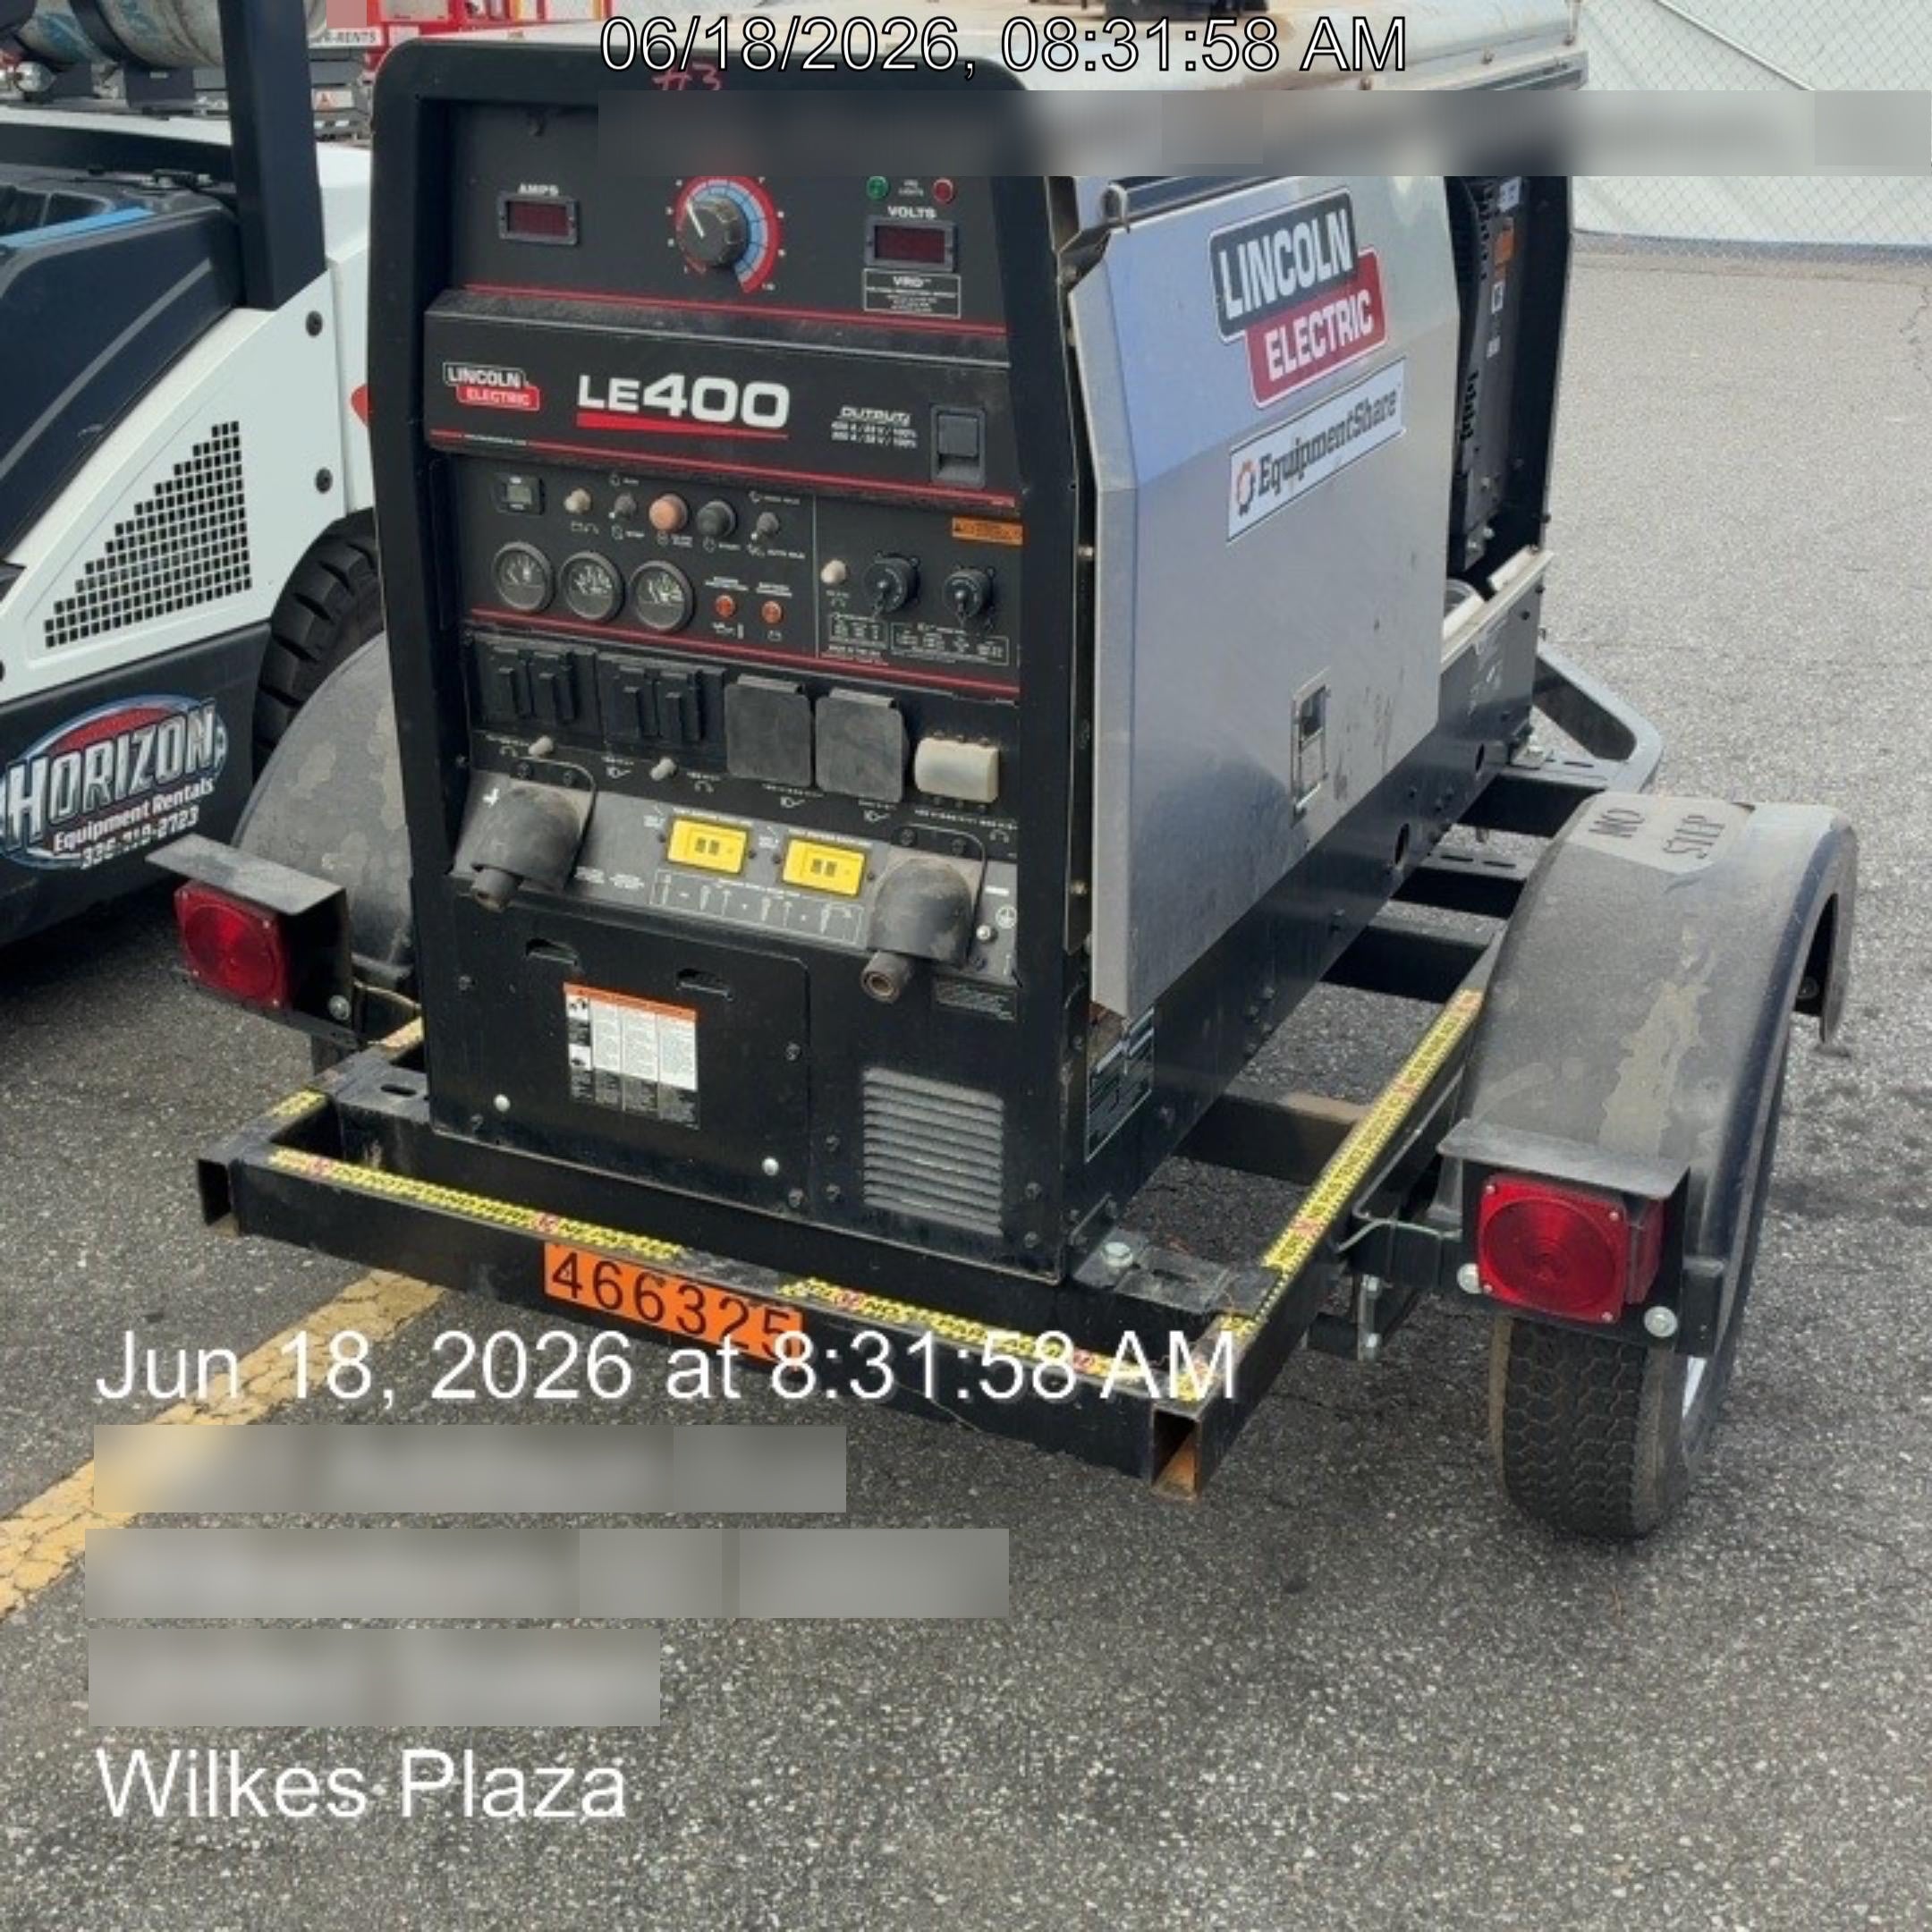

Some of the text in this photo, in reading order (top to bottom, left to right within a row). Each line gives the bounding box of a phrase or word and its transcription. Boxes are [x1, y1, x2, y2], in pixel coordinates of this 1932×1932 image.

[887, 205, 937, 218] VOLTS
[1218, 209, 1355, 318] LINCOLN
[1264, 289, 1375, 382] ELECTRIC
[448, 367, 521, 389] LINCOLN
[466, 386, 531, 406] ELECTRIC
[578, 373, 791, 428] LE400
[1258, 389, 1397, 497] EquipmentShare
[7, 703, 216, 846] HORIZON
[54, 777, 215, 852] Equipment Rentals
[1589, 808, 1725, 860] NO STEP
[553, 1252, 792, 1360] 466325
